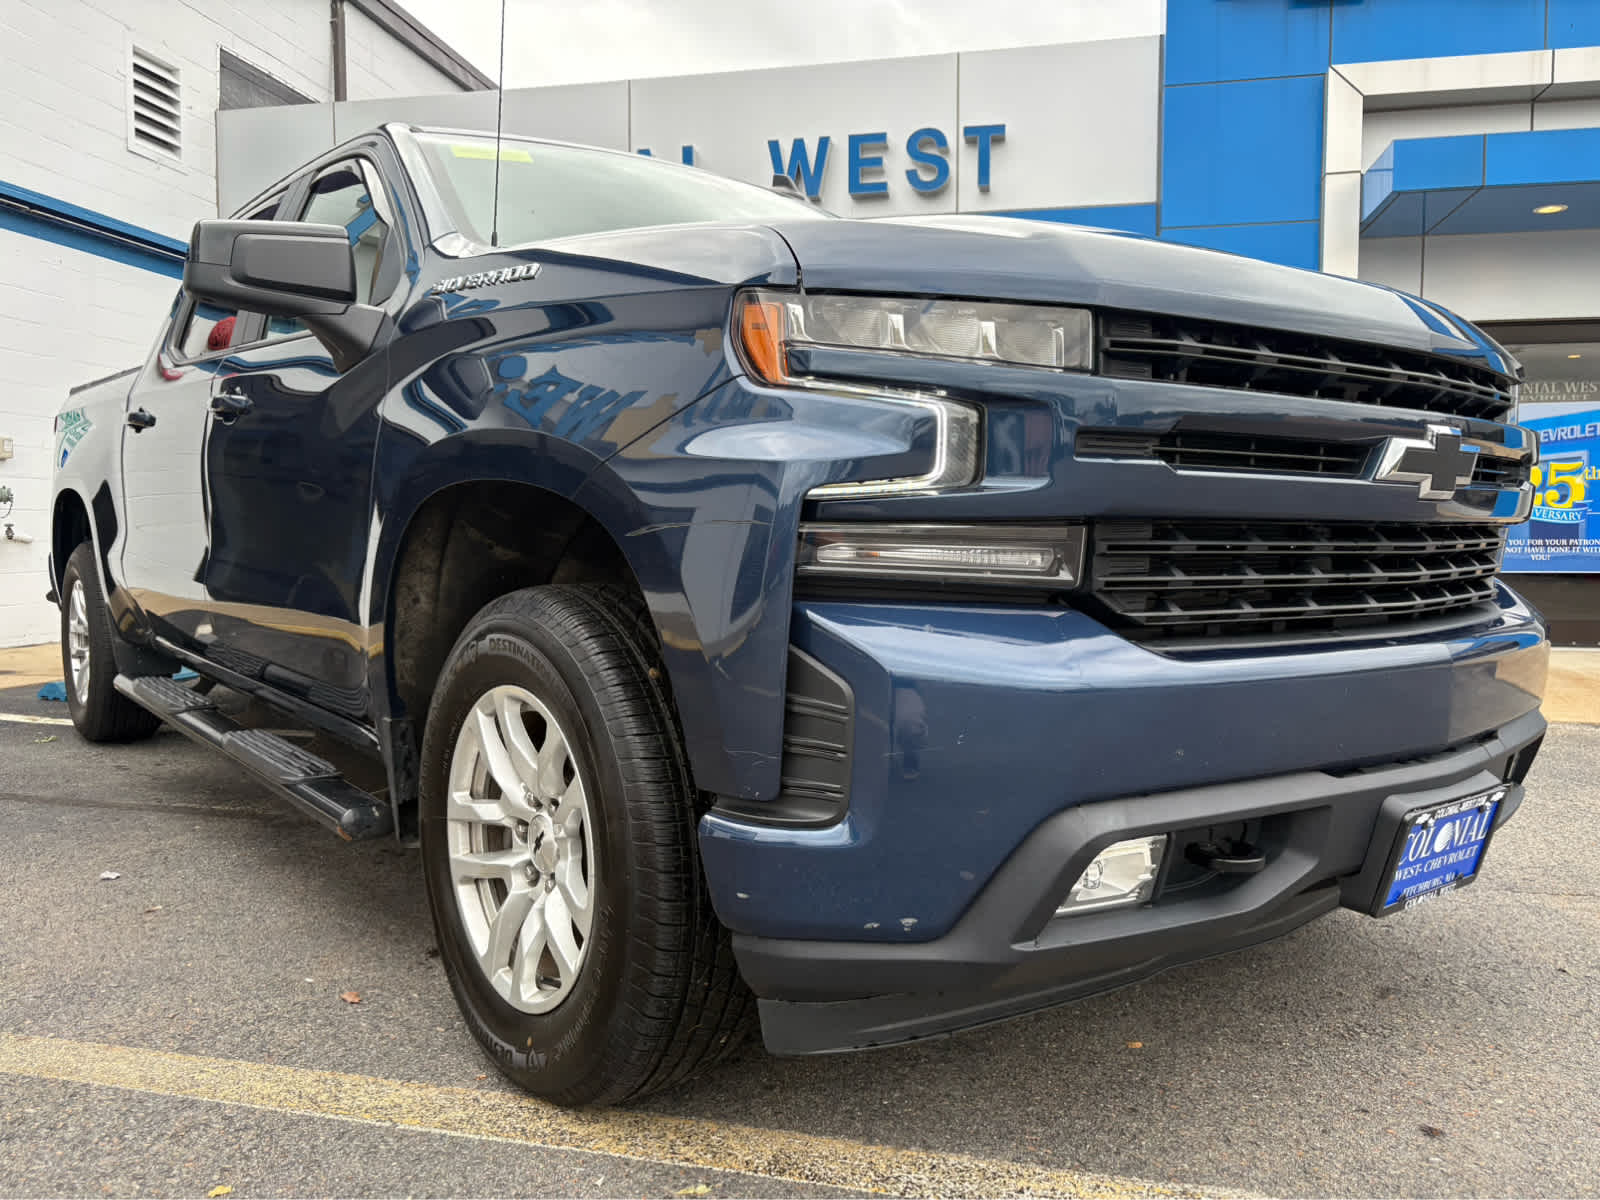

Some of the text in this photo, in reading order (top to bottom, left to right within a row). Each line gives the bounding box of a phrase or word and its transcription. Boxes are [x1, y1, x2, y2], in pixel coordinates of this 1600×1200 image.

[767, 124, 1006, 201] WEST
[1395, 845, 1478, 881] WEST CHEVROLET
